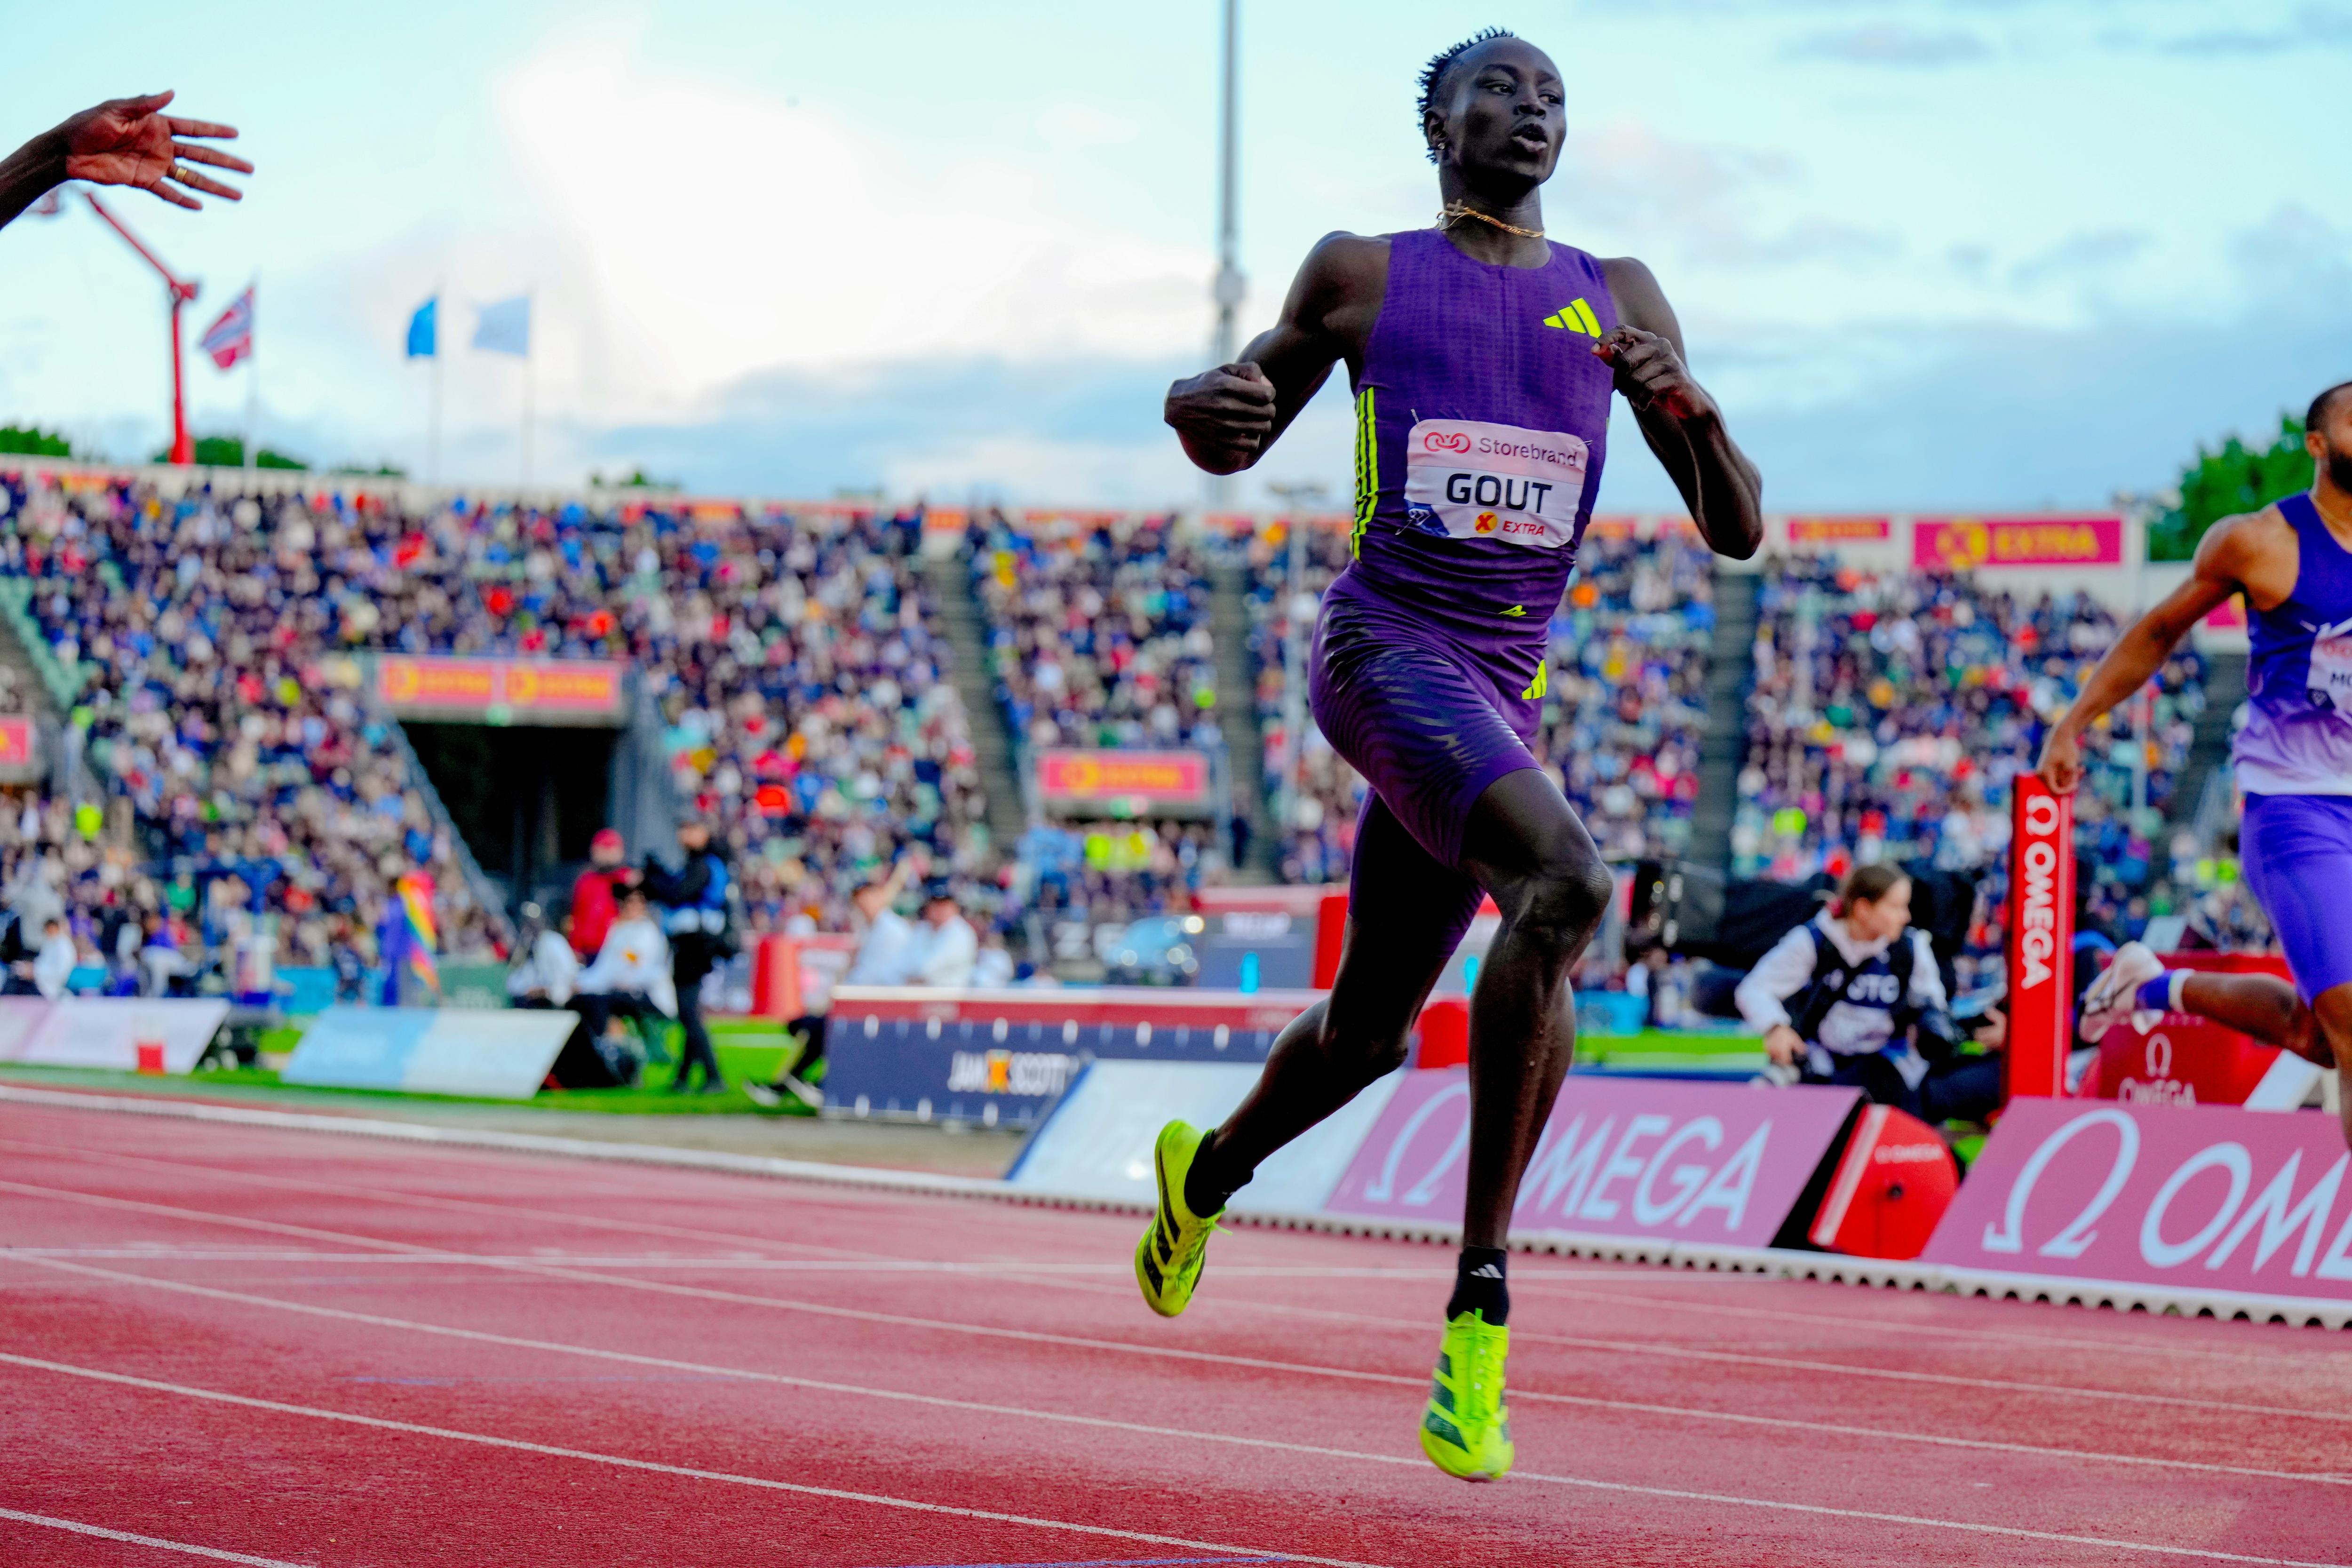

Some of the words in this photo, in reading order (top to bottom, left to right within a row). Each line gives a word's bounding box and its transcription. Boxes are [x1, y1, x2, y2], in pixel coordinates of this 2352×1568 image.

[1479, 437, 1578, 467] Storebrand
[1446, 473, 1553, 514] GOUT
[1502, 520, 1545, 536] EXTRA
[2021, 841, 2057, 990] OMEGA
[1513, 1111, 1773, 1232] MEGA
